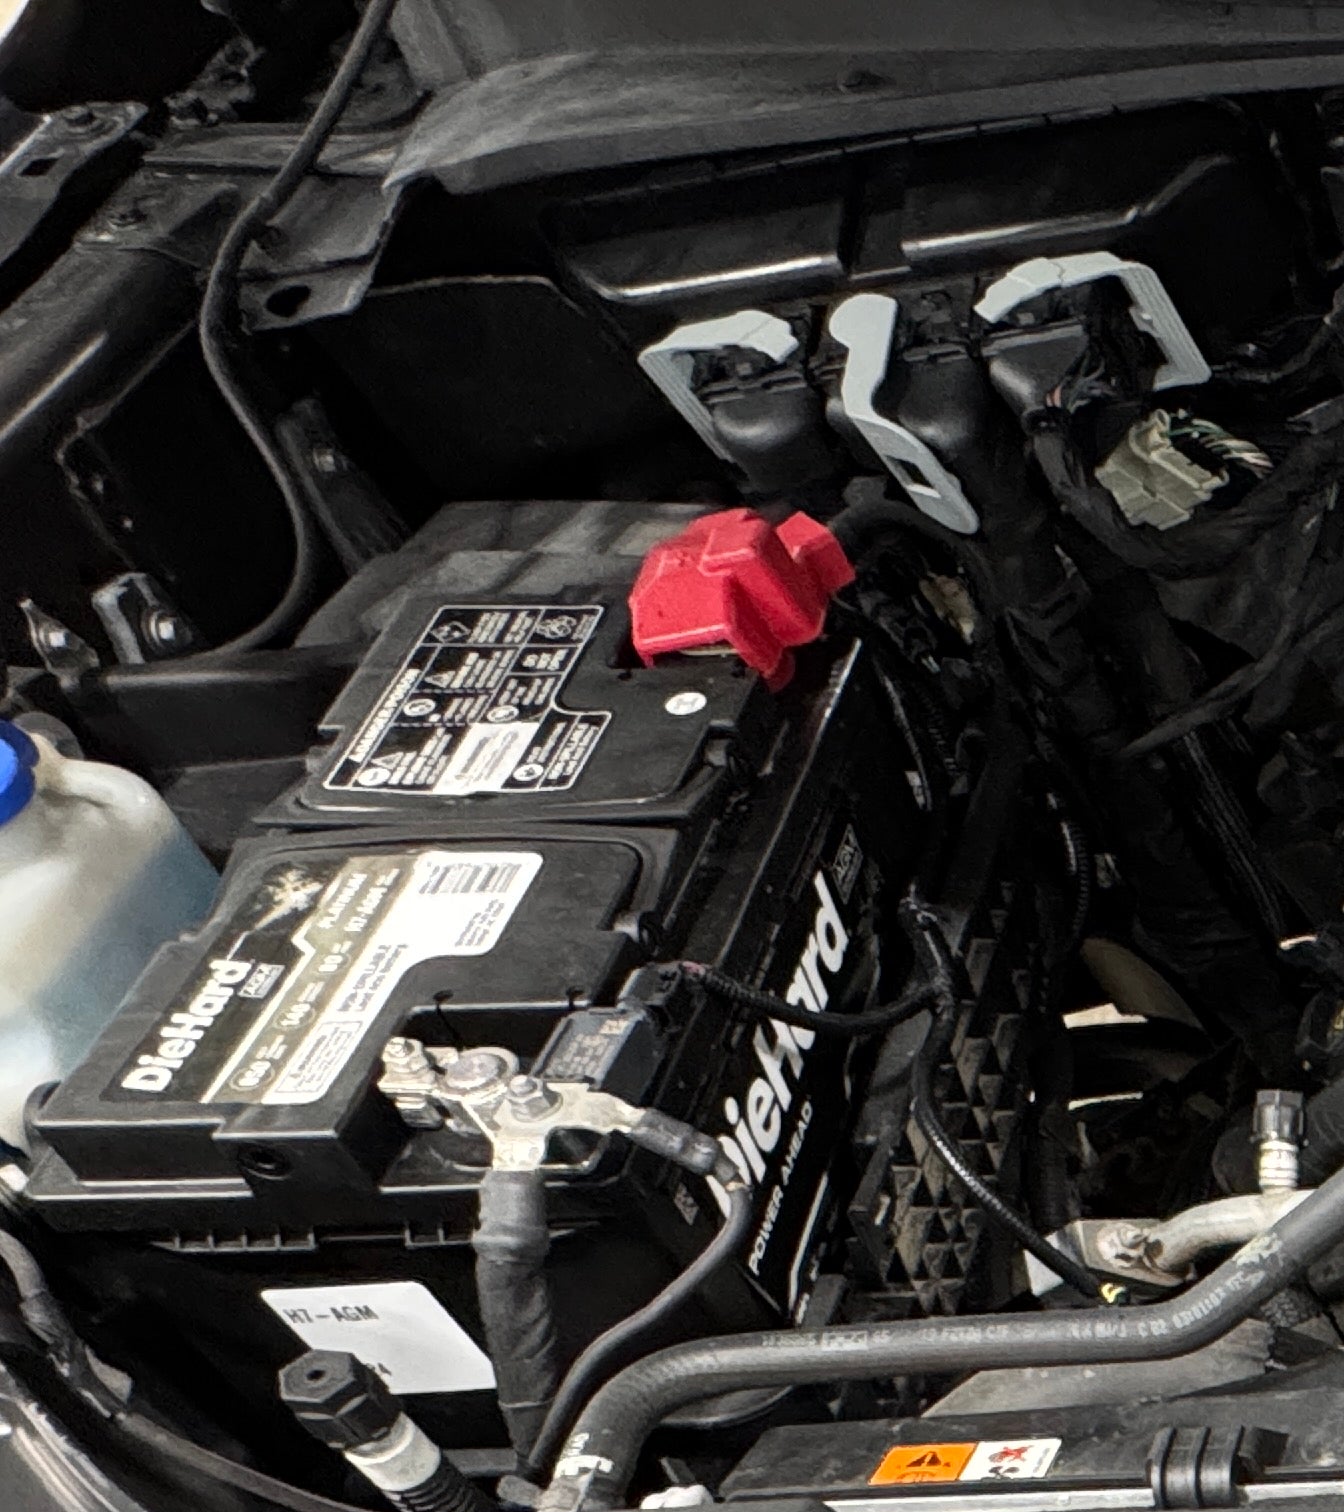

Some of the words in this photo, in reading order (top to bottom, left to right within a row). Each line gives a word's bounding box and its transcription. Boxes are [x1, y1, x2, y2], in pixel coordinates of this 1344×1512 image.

[121, 959, 252, 1092] DieHard
[748, 1184, 784, 1276] POWER
[780, 1101, 813, 1186] AHEAD
[282, 1304, 379, 1324] H7-AGM
